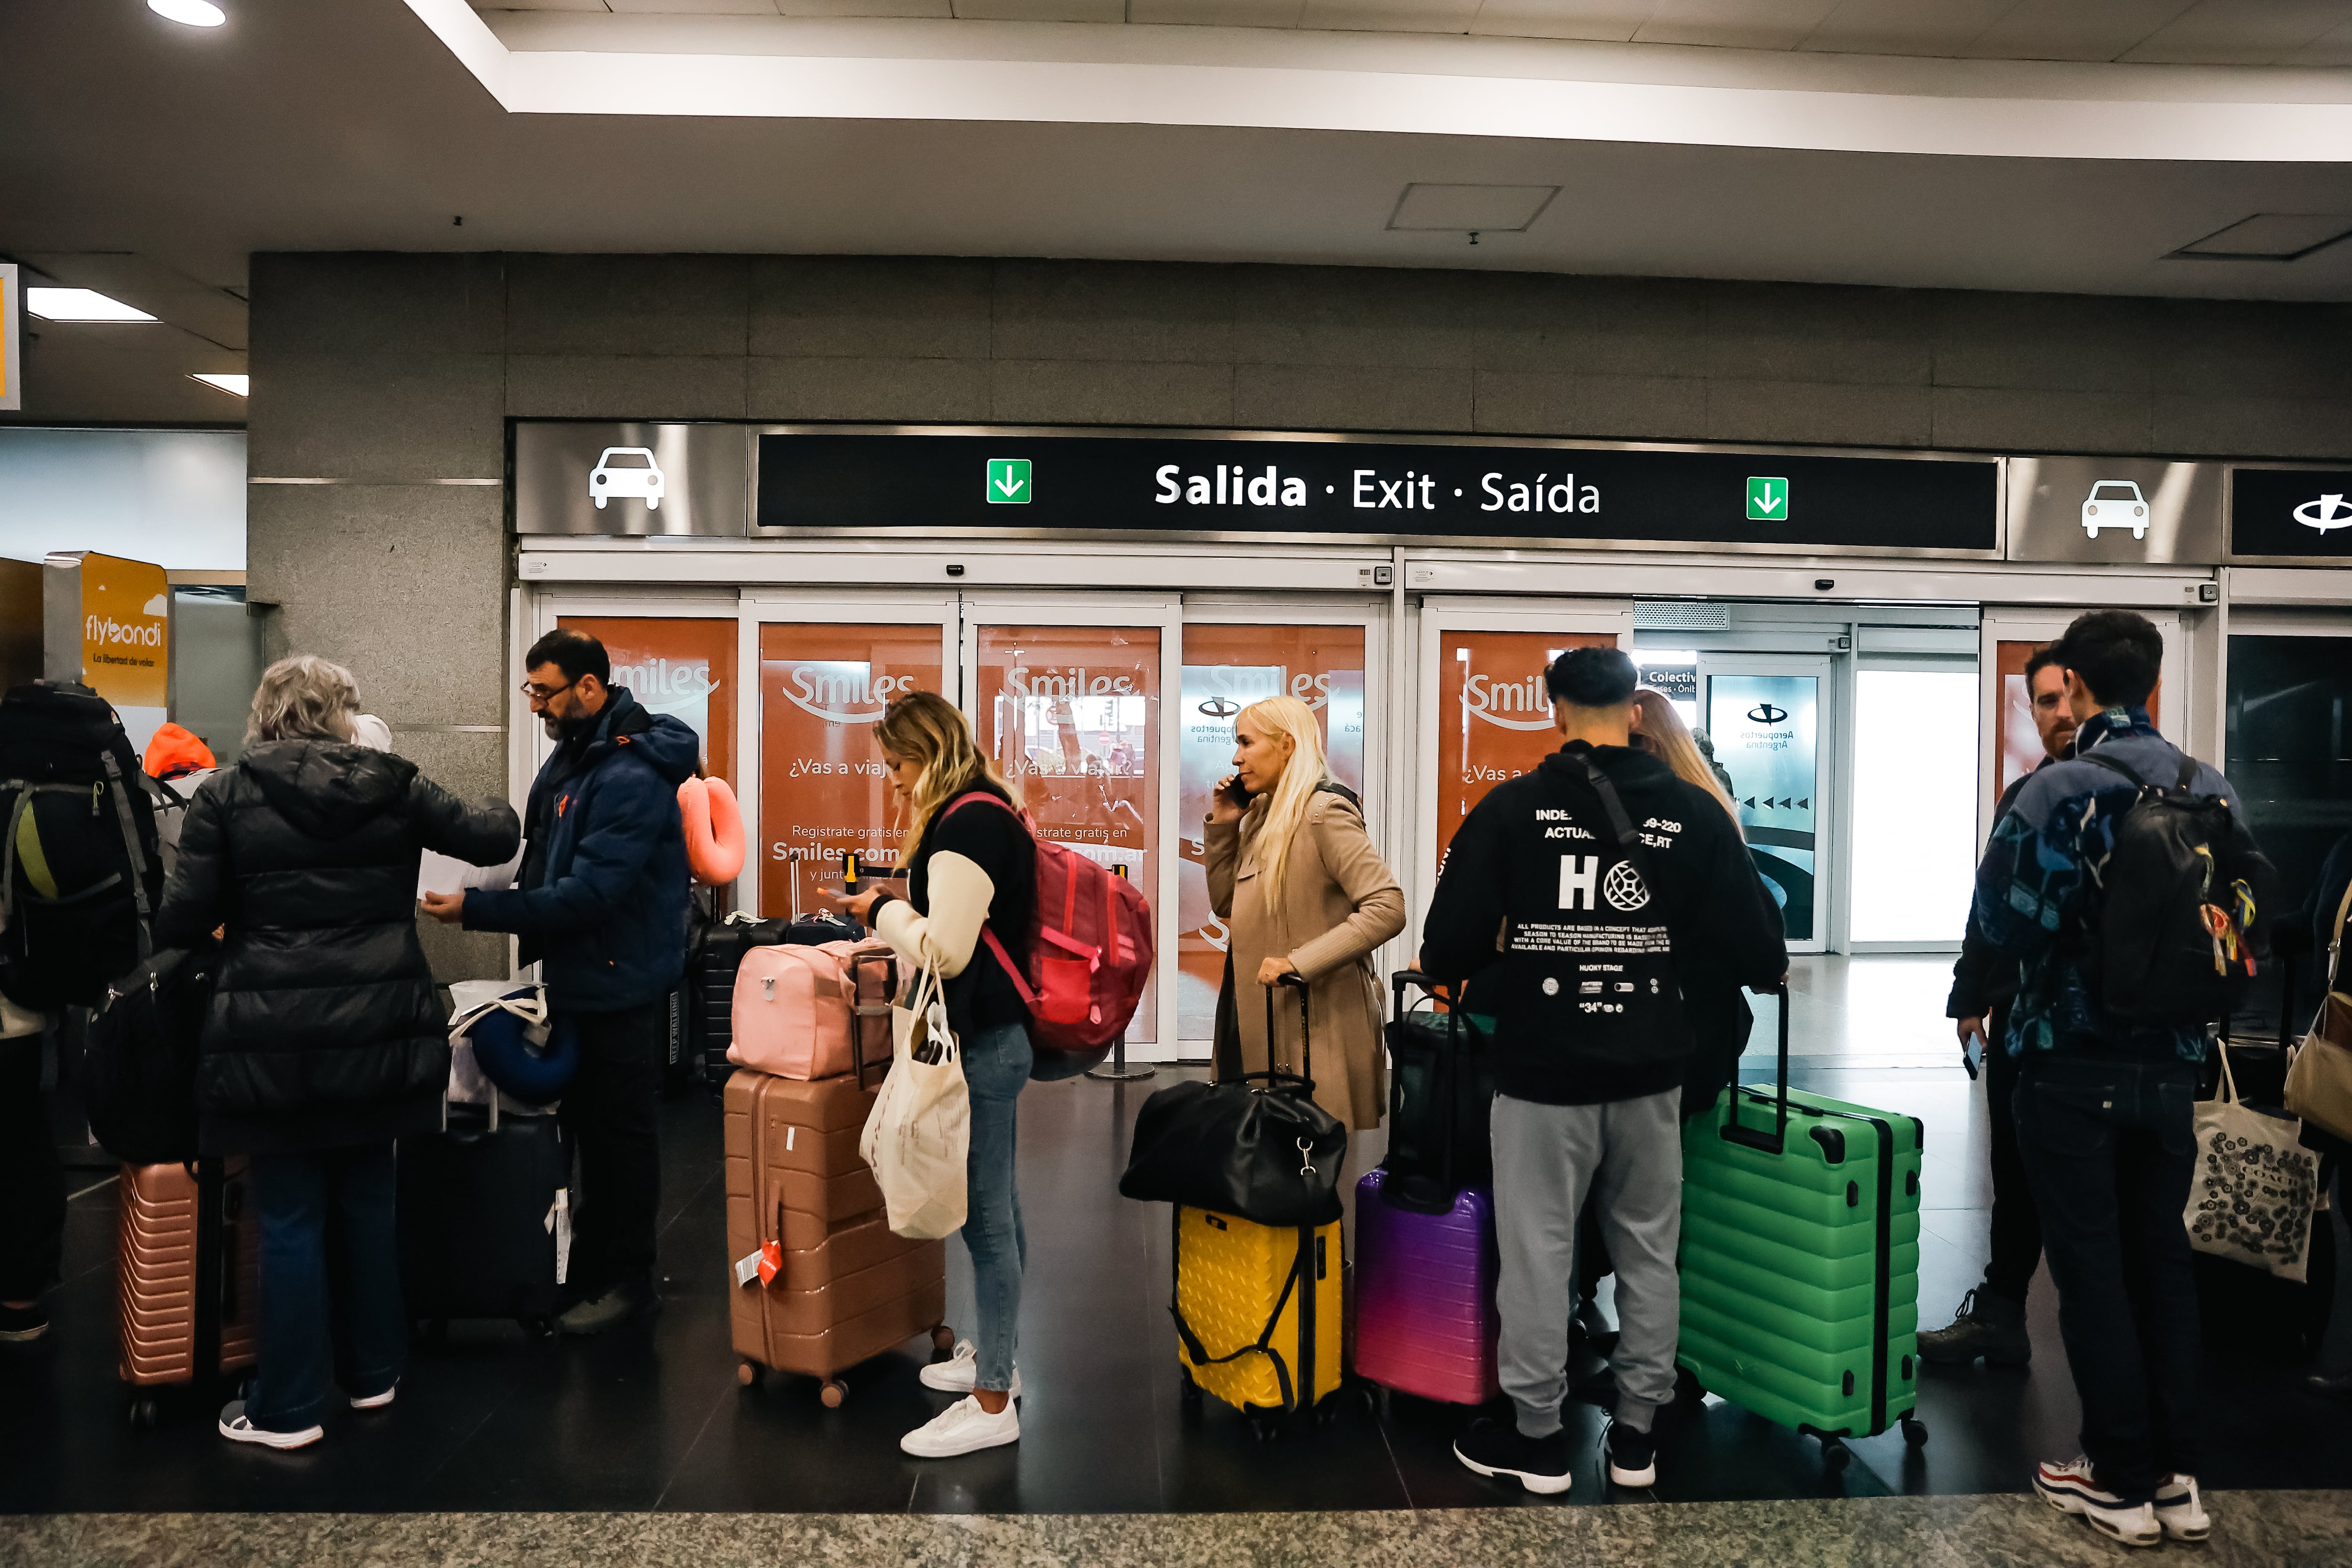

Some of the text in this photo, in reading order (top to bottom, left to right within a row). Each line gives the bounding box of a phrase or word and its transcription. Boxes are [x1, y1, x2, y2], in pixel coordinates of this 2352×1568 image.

[1155, 464, 1600, 513] Salida Exit Saída
[86, 615, 161, 647] flybondi
[94, 653, 154, 667] La libertad de volar
[611, 658, 720, 714] miles
[1202, 664, 1340, 708] Smiles
[1649, 671, 1695, 683] Colectiv
[782, 666, 914, 722] Smiles
[999, 667, 1141, 713] Smiles
[1459, 674, 1554, 729] Smil
[789, 758, 886, 779] ¿Vas a viaj
[1463, 764, 1506, 784] ¿Vas
[1536, 809, 1572, 820] INDE
[792, 825, 854, 839] Registrate
[858, 827, 892, 840] gratis
[1036, 827, 1128, 840] strate gratis en
[1545, 827, 1596, 839] ACTUA
[810, 868, 843, 881] y junt
